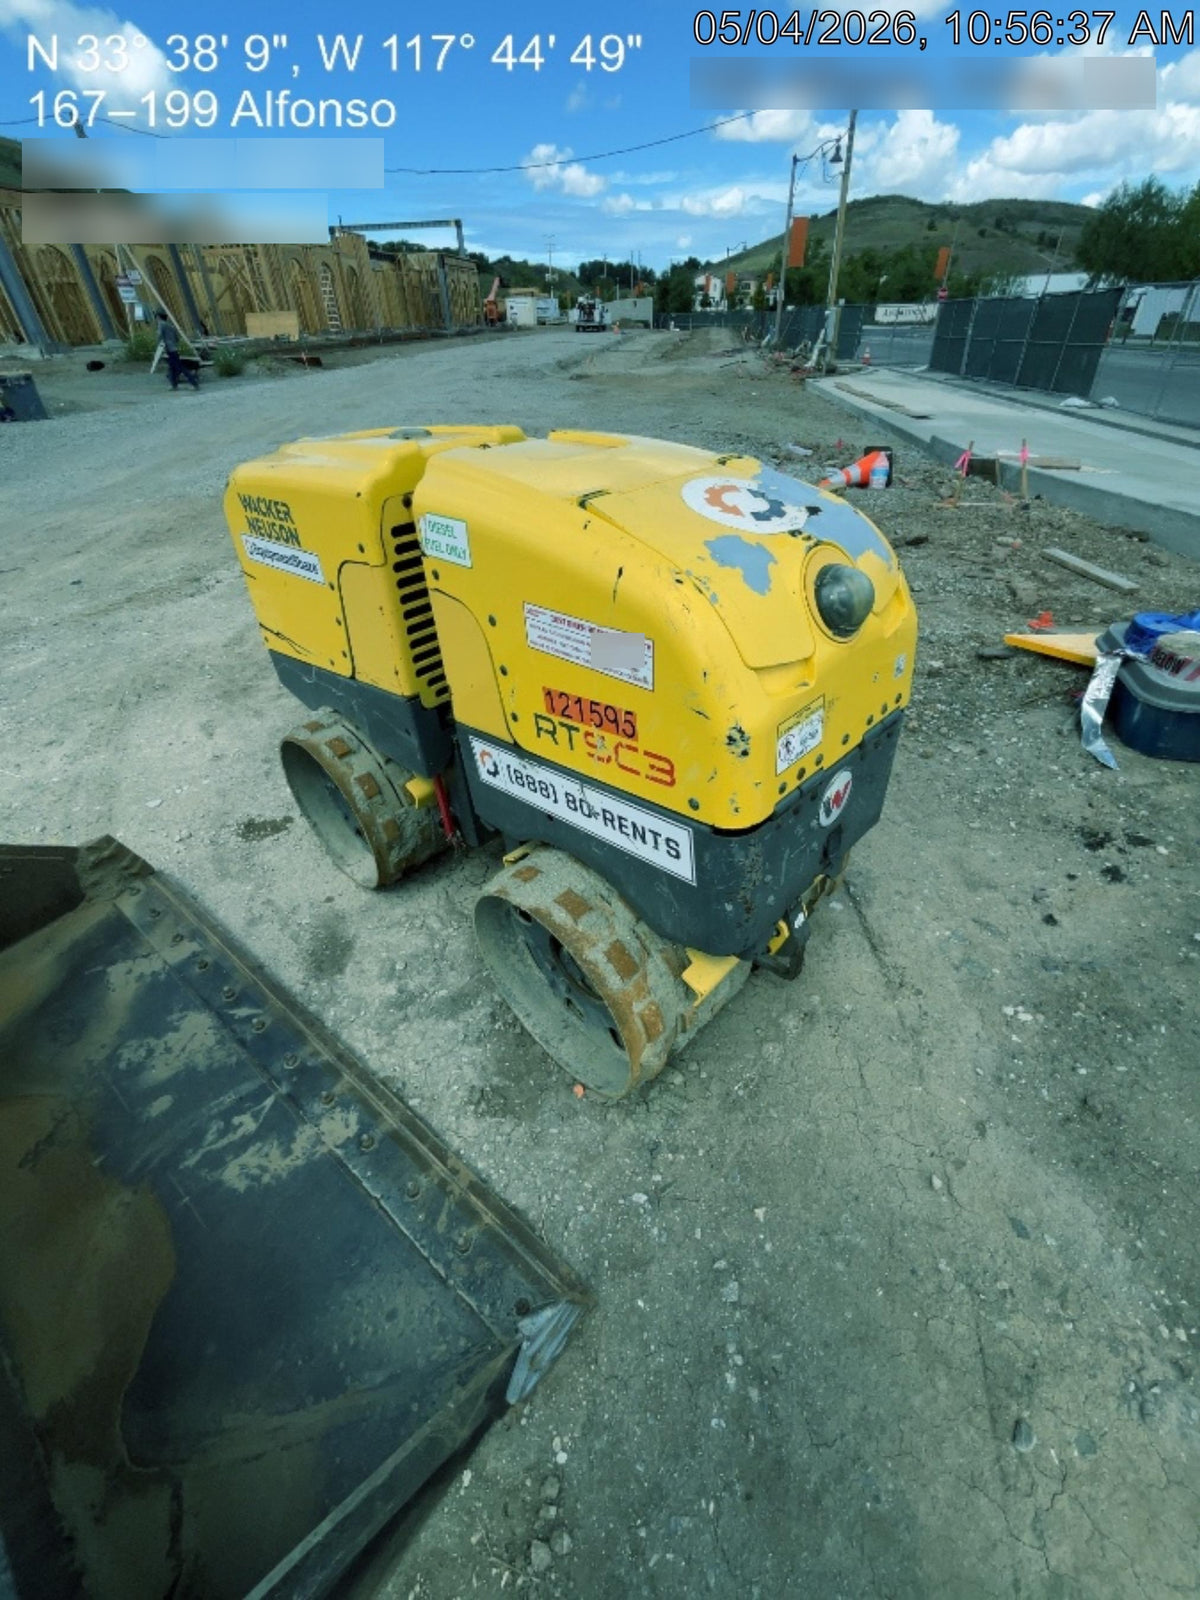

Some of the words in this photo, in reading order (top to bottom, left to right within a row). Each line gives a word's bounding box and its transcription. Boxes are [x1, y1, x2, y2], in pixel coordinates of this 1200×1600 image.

[237, 492, 295, 526] WACKER
[245, 514, 302, 548] NEUSON
[544, 689, 637, 740] 121595
[506, 763, 558, 805] (888)
